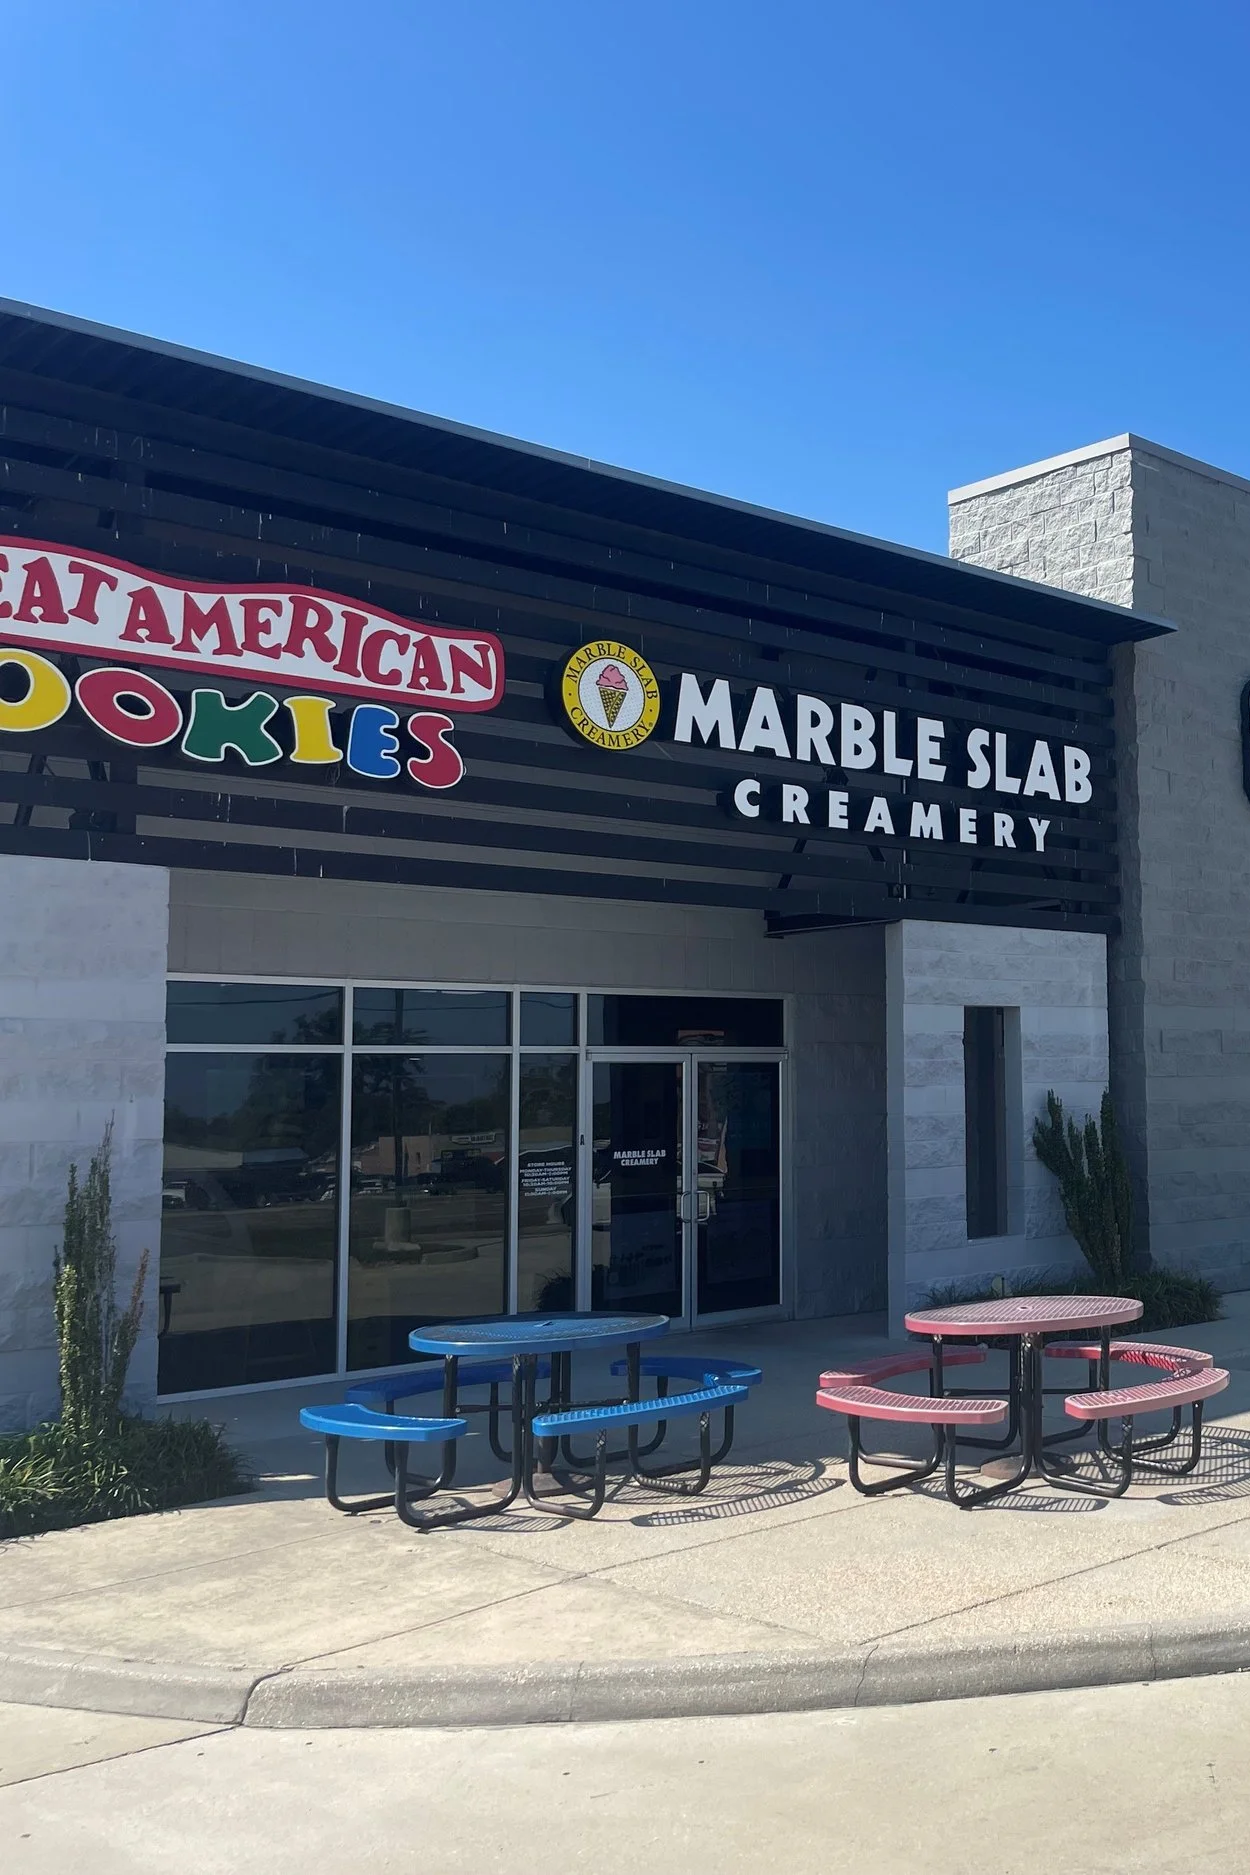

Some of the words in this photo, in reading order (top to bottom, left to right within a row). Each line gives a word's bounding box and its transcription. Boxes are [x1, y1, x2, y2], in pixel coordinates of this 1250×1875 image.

[118, 585, 491, 694] AMERICAN
[566, 642, 627, 683] MARBLE
[630, 656, 658, 699] SLAB
[570, 706, 650, 748] CREAMERY
[674, 672, 947, 782] MARBLE
[967, 728, 1093, 804] SLAB
[734, 778, 1051, 852] CREAMERY
[613, 1151, 645, 1159] MARBLE
[646, 1150, 666, 1158] SLAB
[620, 1157, 659, 1166] CREAMERY
